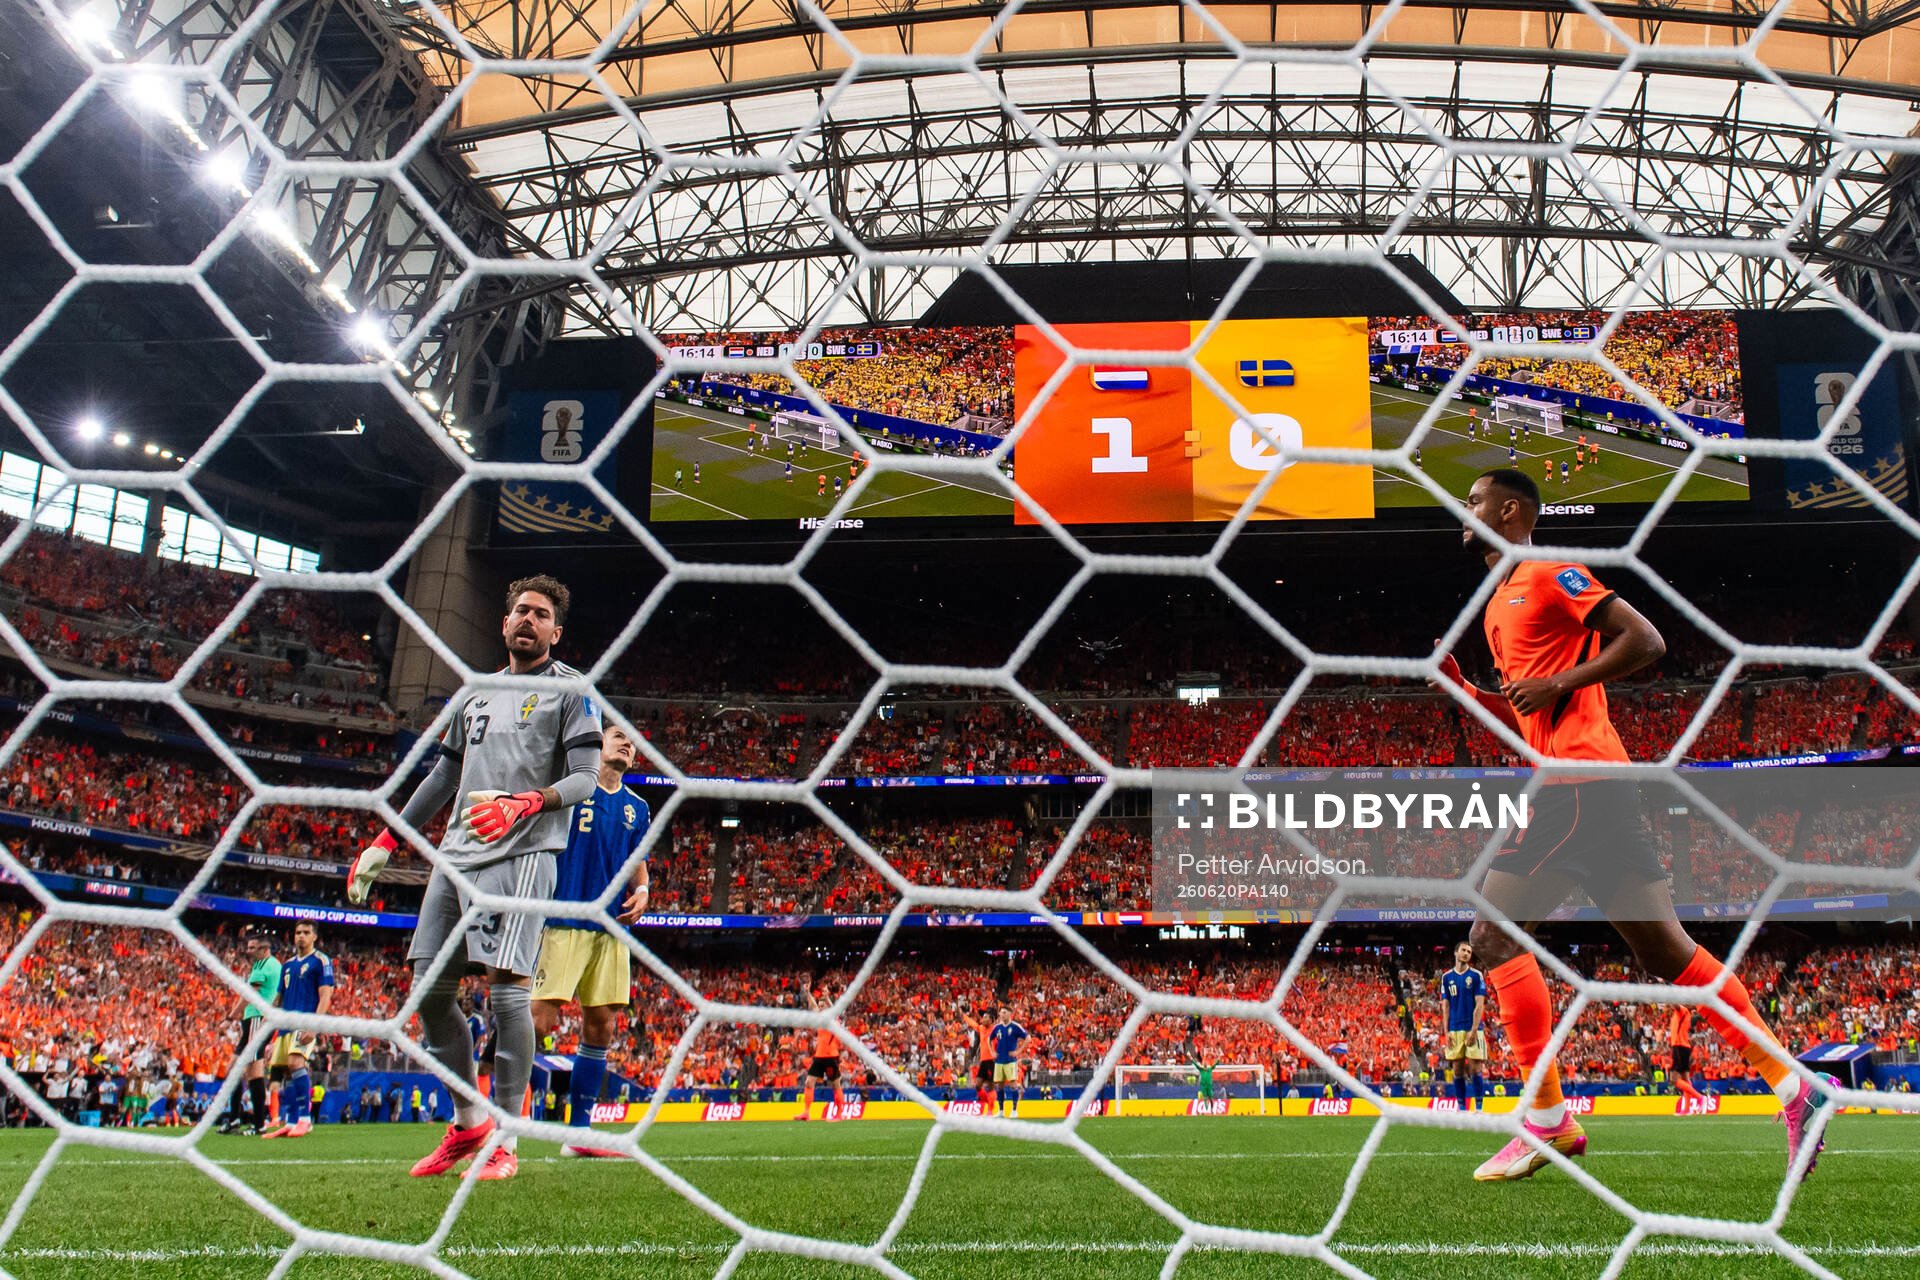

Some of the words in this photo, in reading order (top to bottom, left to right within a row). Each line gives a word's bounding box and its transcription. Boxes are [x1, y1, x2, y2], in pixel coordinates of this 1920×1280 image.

[1390, 332, 1428, 342] 16:14
[1527, 330, 1534, 340] 0
[1542, 329, 1562, 338] SWE
[678, 348, 715, 359] 16:14
[756, 346, 774, 356] NED
[812, 346, 818, 356] 0
[826, 345, 846, 356] SWE
[1091, 418, 1148, 472] 1
[1230, 413, 1303, 471] 0
[1830, 445, 1864, 454] 026
[1539, 504, 1595, 515] isense
[800, 518, 864, 530] Hisnse
[1751, 759, 1780, 768] WORLD
[1781, 758, 1797, 766] CUP
[645, 776, 662, 784] FIFA
[31, 818, 92, 837] HOUSTON
[248, 856, 266, 864] FIFA
[267, 858, 295, 870] WORLD
[296, 862, 311, 870] CUP
[86, 882, 130, 896] HOUSTON
[274, 906, 294, 917] FIFA
[295, 908, 326, 920] WORLD
[328, 912, 344, 922] CUP
[344, 914, 378, 924] 2026
[1379, 911, 1400, 920] FIFA
[1400, 911, 1436, 920] WORLD
[1436, 910, 1456, 919] CUP
[1458, 910, 1477, 919] 20
[636, 916, 666, 925] ORLD
[666, 917, 687, 926] CUP
[688, 917, 722, 926] 2026
[834, 916, 882, 926] HOUSTON
[1313, 1098, 1348, 1115] Lay's
[1564, 1096, 1592, 1114] ay's
[590, 1103, 624, 1122] Lay's
[706, 1102, 742, 1120] Lay's
